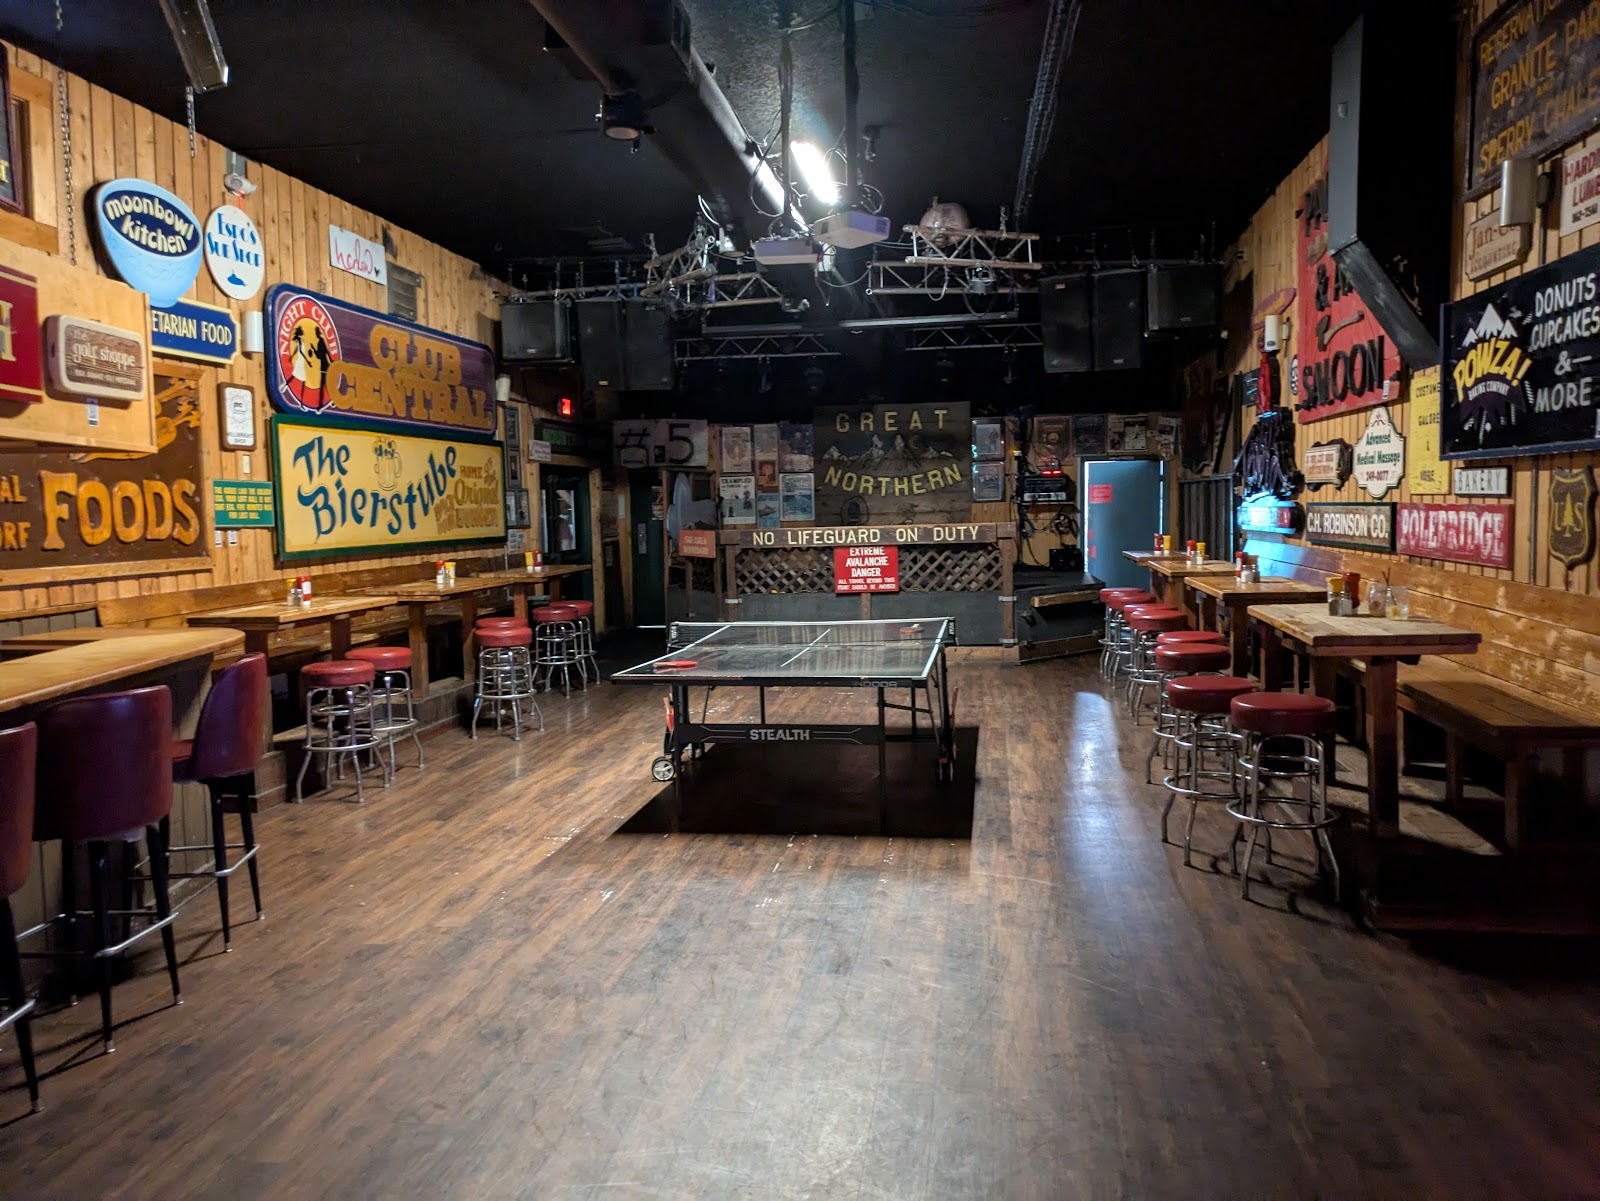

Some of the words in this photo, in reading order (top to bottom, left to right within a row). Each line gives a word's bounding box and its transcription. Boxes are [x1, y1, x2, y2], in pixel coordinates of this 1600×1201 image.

[1491, 31, 1558, 110] GRANITE
[1479, 112, 1536, 174] SPERRY
[104, 194, 196, 242] moonbowl
[121, 214, 188, 255] kitchen
[232, 239, 262, 268] SHOP
[1535, 272, 1597, 318] DONUTS
[201, 321, 233, 346] FOOD
[278, 300, 307, 357] NIGHT
[310, 301, 340, 356] CLUB
[1528, 305, 1600, 353] CUPCAKES
[72, 342, 98, 367] golf
[100, 346, 136, 371] shoppe
[369, 323, 463, 387] CLUB
[1453, 336, 1533, 403] POWZA!
[326, 360, 494, 429] CENTRAL
[1467, 382, 1486, 401] BAKING
[1486, 380, 1510, 397] COMPANY
[1535, 376, 1594, 413] MORE
[835, 409, 949, 433] GREAT
[1417, 411, 1441, 427] GALORE
[1365, 429, 1391, 446] Advanced
[292, 435, 351, 484] The
[1356, 450, 1376, 466] Medical
[1377, 450, 1401, 467] Massage
[296, 446, 458, 541] Bierstube
[824, 462, 963, 498] NORTHERN
[1458, 469, 1501, 492] BAKERY
[40, 469, 200, 550] FOODS
[1307, 513, 1322, 533] C.H.
[1323, 512, 1369, 538] ROBINSON
[1370, 514, 1389, 539] CO.
[0, 521, 32, 549] RF
[752, 531, 775, 546] NO
[787, 528, 881, 546] LIFEGUARD
[895, 527, 919, 543] ON
[933, 525, 979, 541] DUTY
[1399, 508, 1505, 561] POLEBRIDGE
[845, 556, 889, 568] AVALANCHE
[849, 546, 886, 557] EXTREME
[851, 567, 882, 578] DANGER
[750, 728, 810, 741] STEALTH
